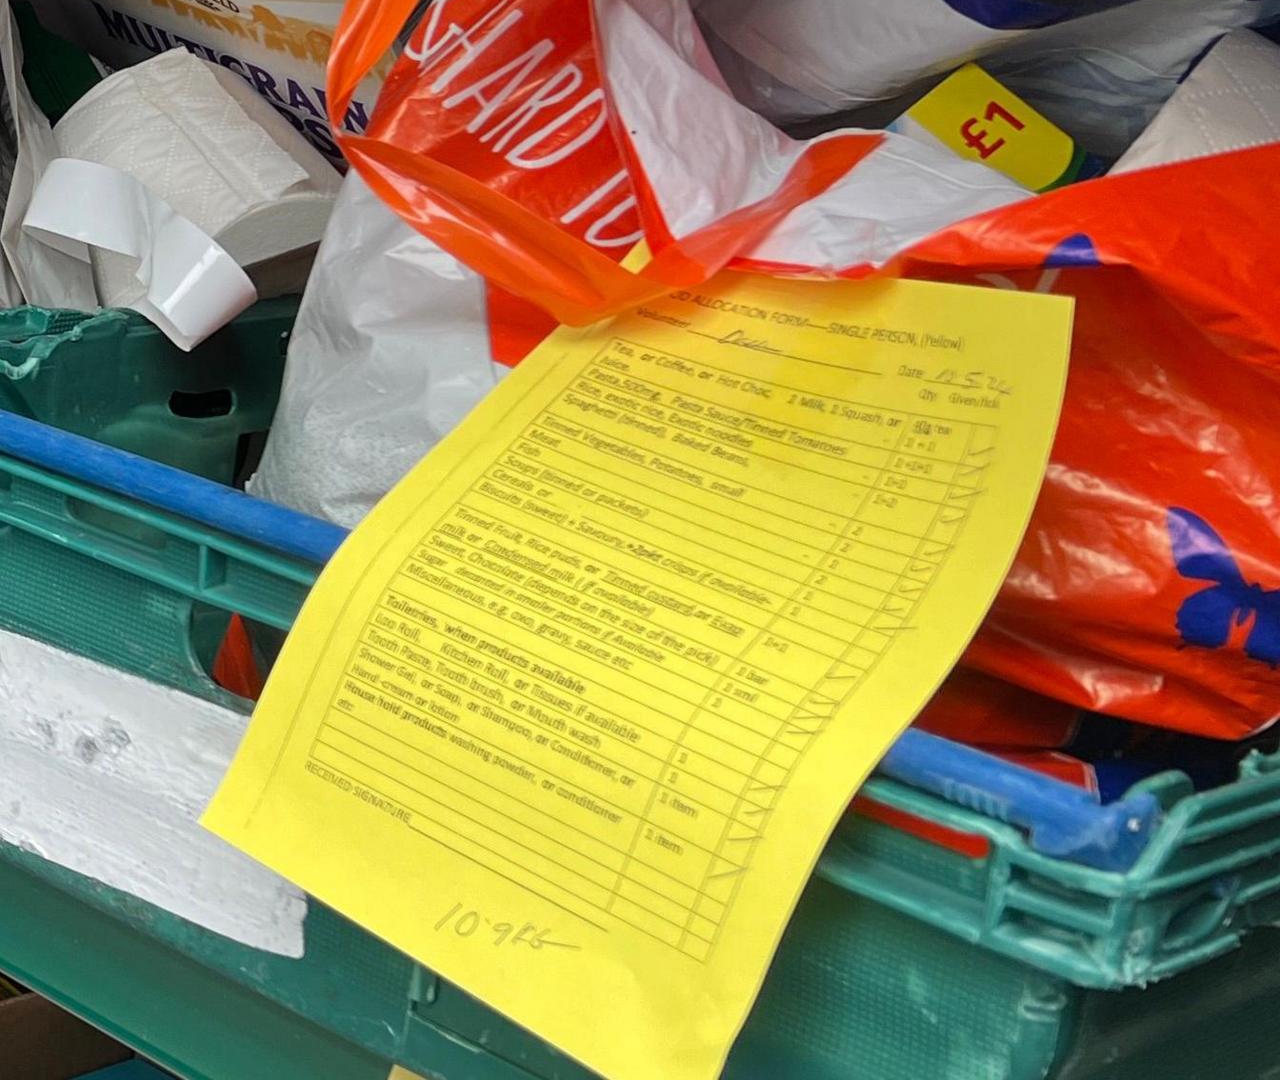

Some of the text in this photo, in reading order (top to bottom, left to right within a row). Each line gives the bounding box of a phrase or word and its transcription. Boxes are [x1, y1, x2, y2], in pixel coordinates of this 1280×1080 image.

[418, 0, 608, 170] HARD
[958, 99, 1026, 162] £1
[693, 295, 766, 320] ALLOCATION
[443, 623, 478, 644] when
[476, 639, 530, 670] products
[529, 662, 587, 695] available
[400, 710, 449, 740] products
[304, 760, 412, 822] RECEIVED SIGNATURE
